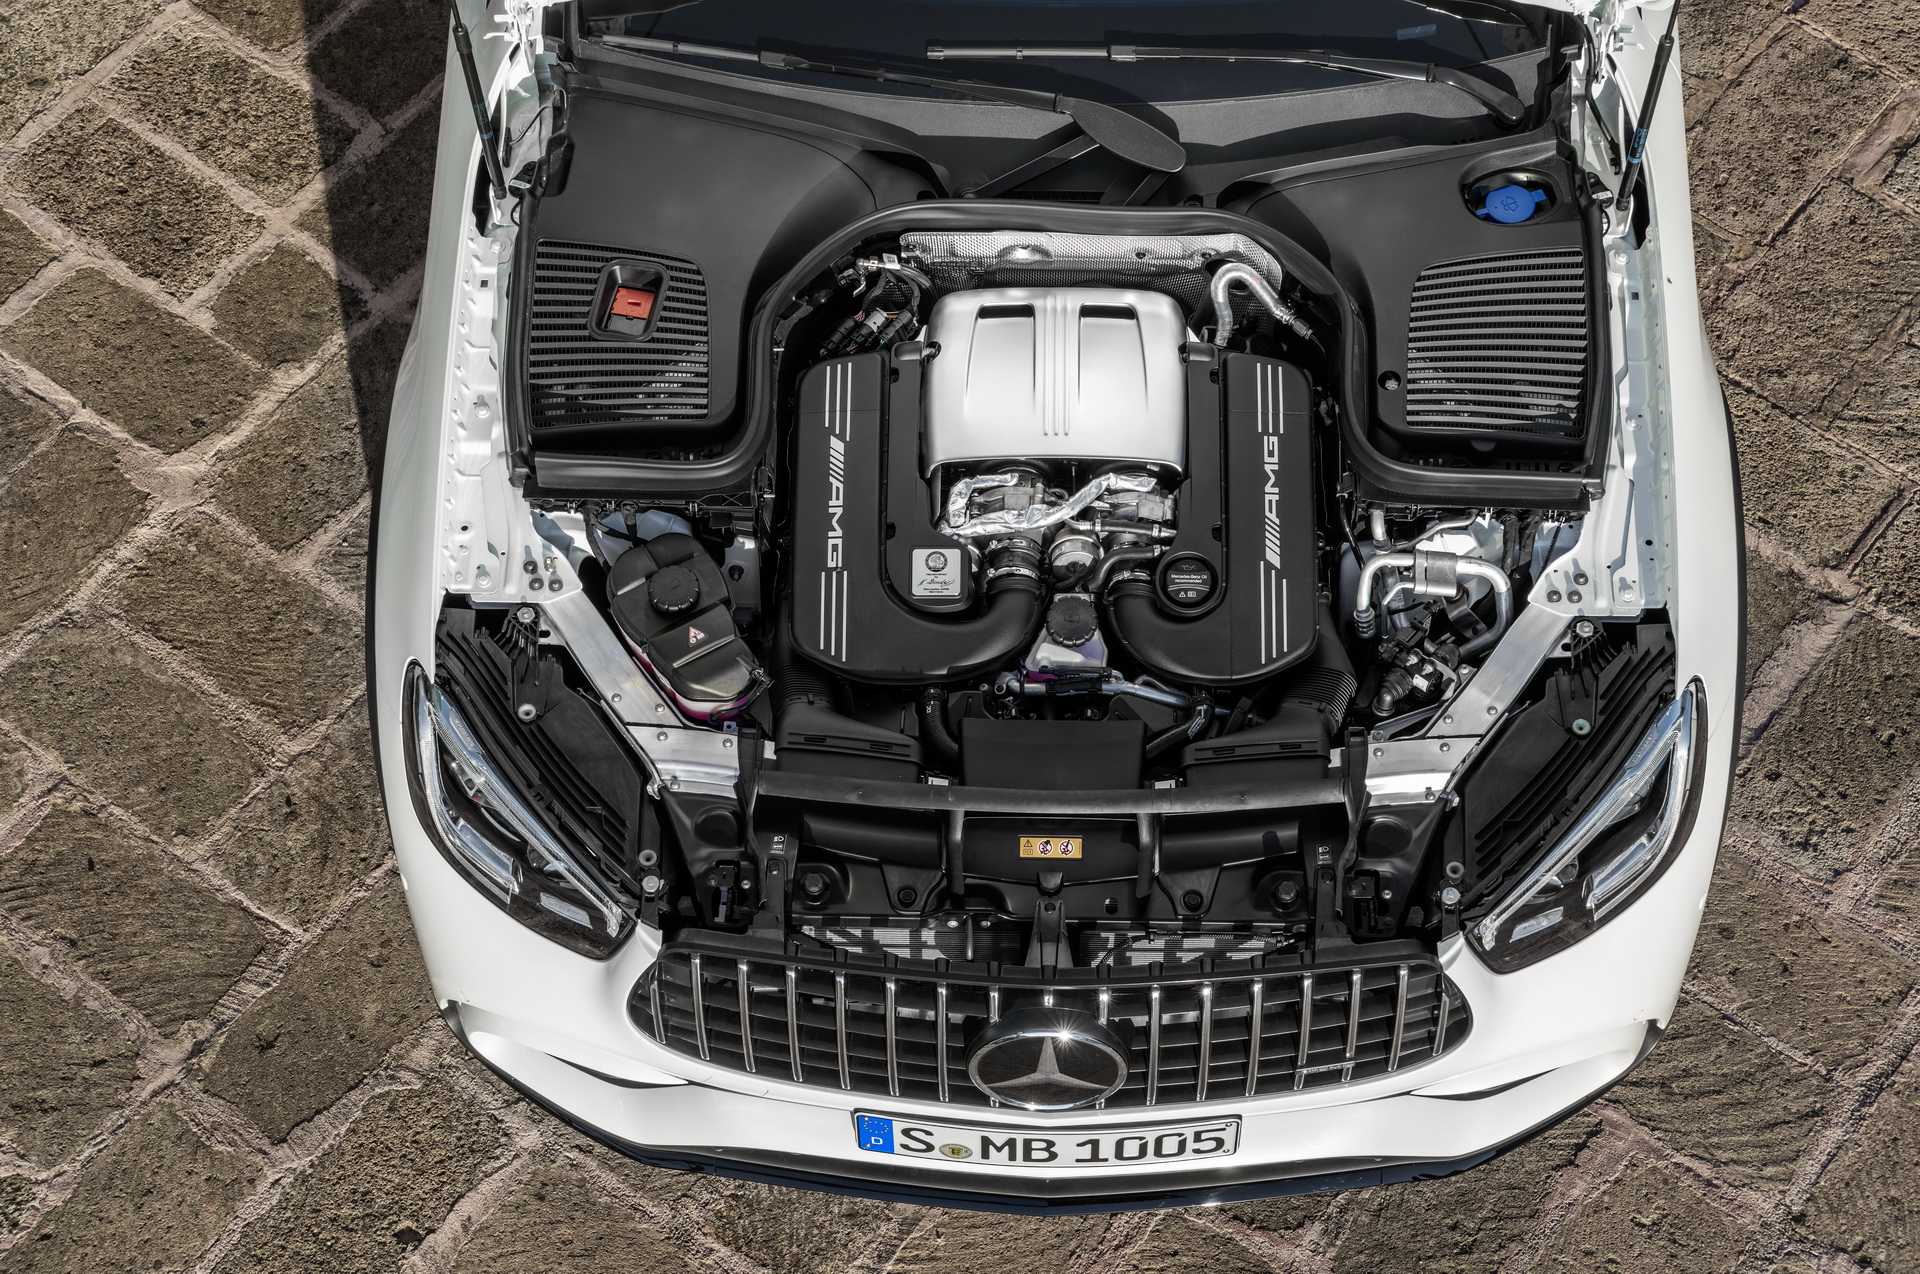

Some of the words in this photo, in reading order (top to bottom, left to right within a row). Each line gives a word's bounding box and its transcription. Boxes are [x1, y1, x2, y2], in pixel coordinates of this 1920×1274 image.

[1263, 435, 1280, 526] AMG
[827, 475, 844, 568] AMG
[871, 1136, 883, 1145] D
[899, 1127, 936, 1154] S
[980, 1135, 1059, 1163] MB
[1075, 1127, 1227, 1163] 1005
